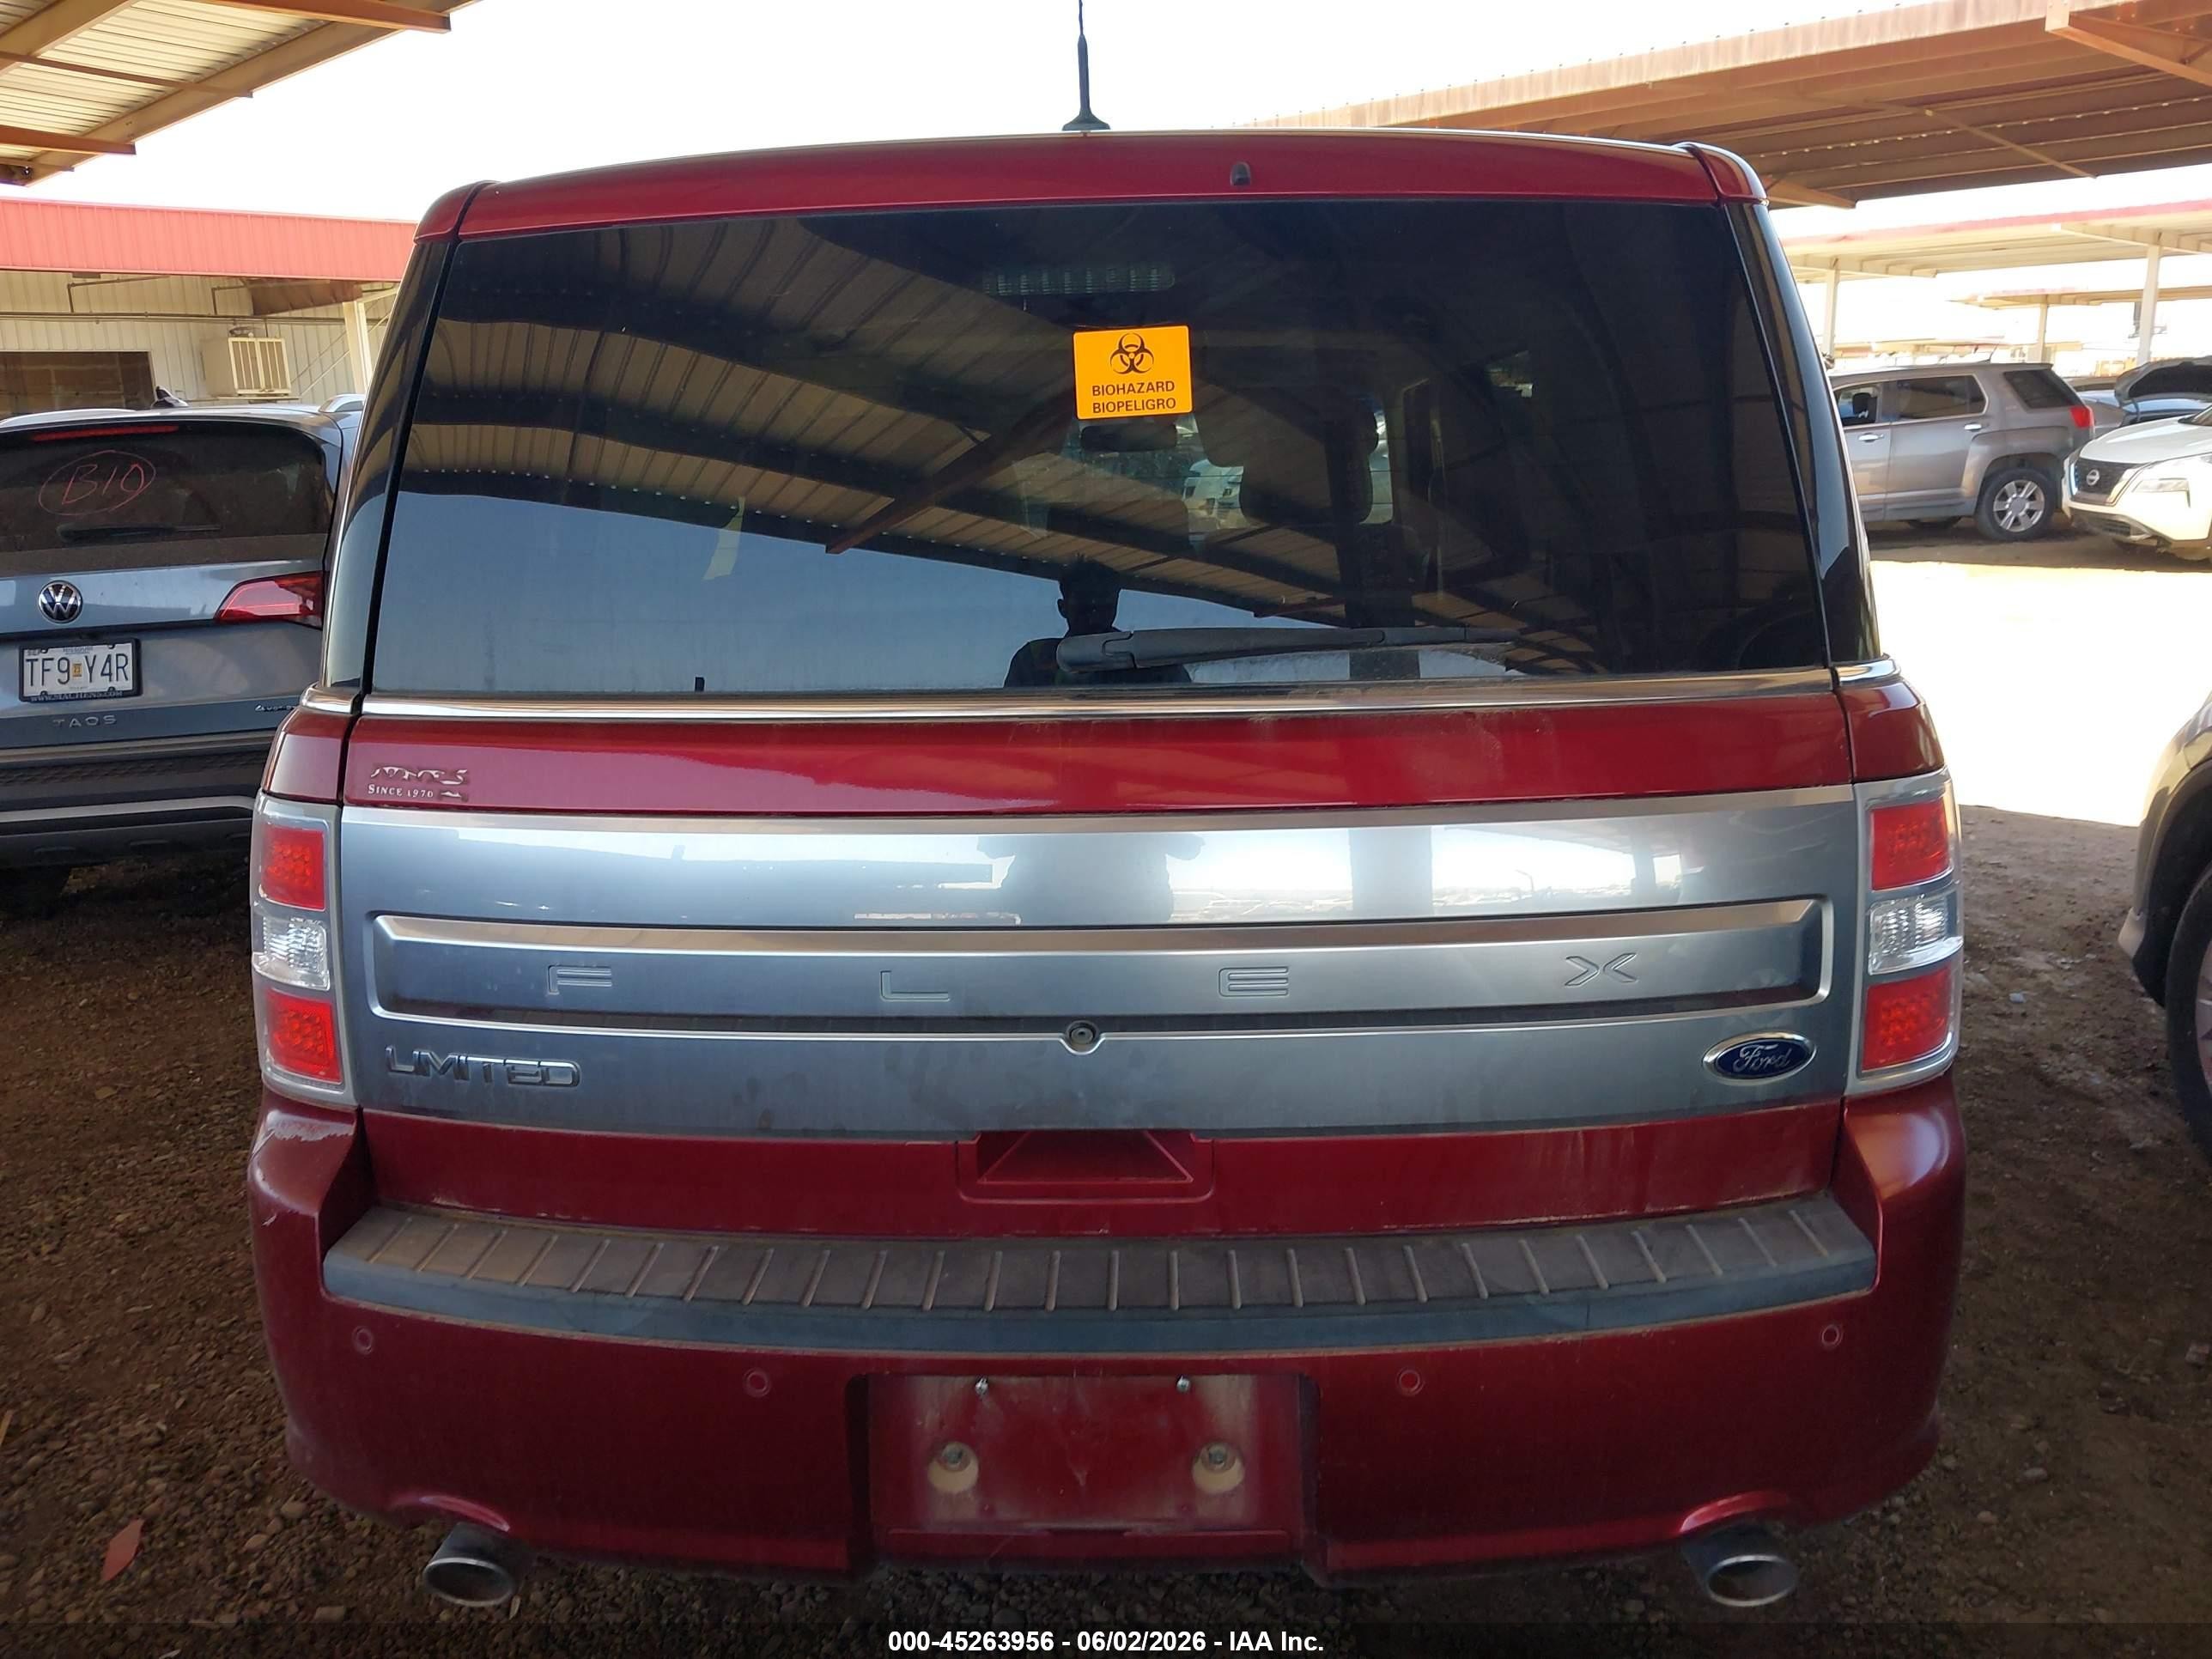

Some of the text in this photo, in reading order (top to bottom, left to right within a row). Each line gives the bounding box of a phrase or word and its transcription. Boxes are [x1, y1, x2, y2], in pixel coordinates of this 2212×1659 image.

[1091, 380, 1176, 397] BIOHAZARD
[1092, 398, 1176, 414] BIOPELIGRO
[25, 653, 129, 687] TF9 Y4R
[52, 714, 118, 728] TAOS
[407, 789, 434, 798] 1970
[1732, 1042, 1793, 1073] Ford
[385, 1045, 582, 1088] LIMITED
